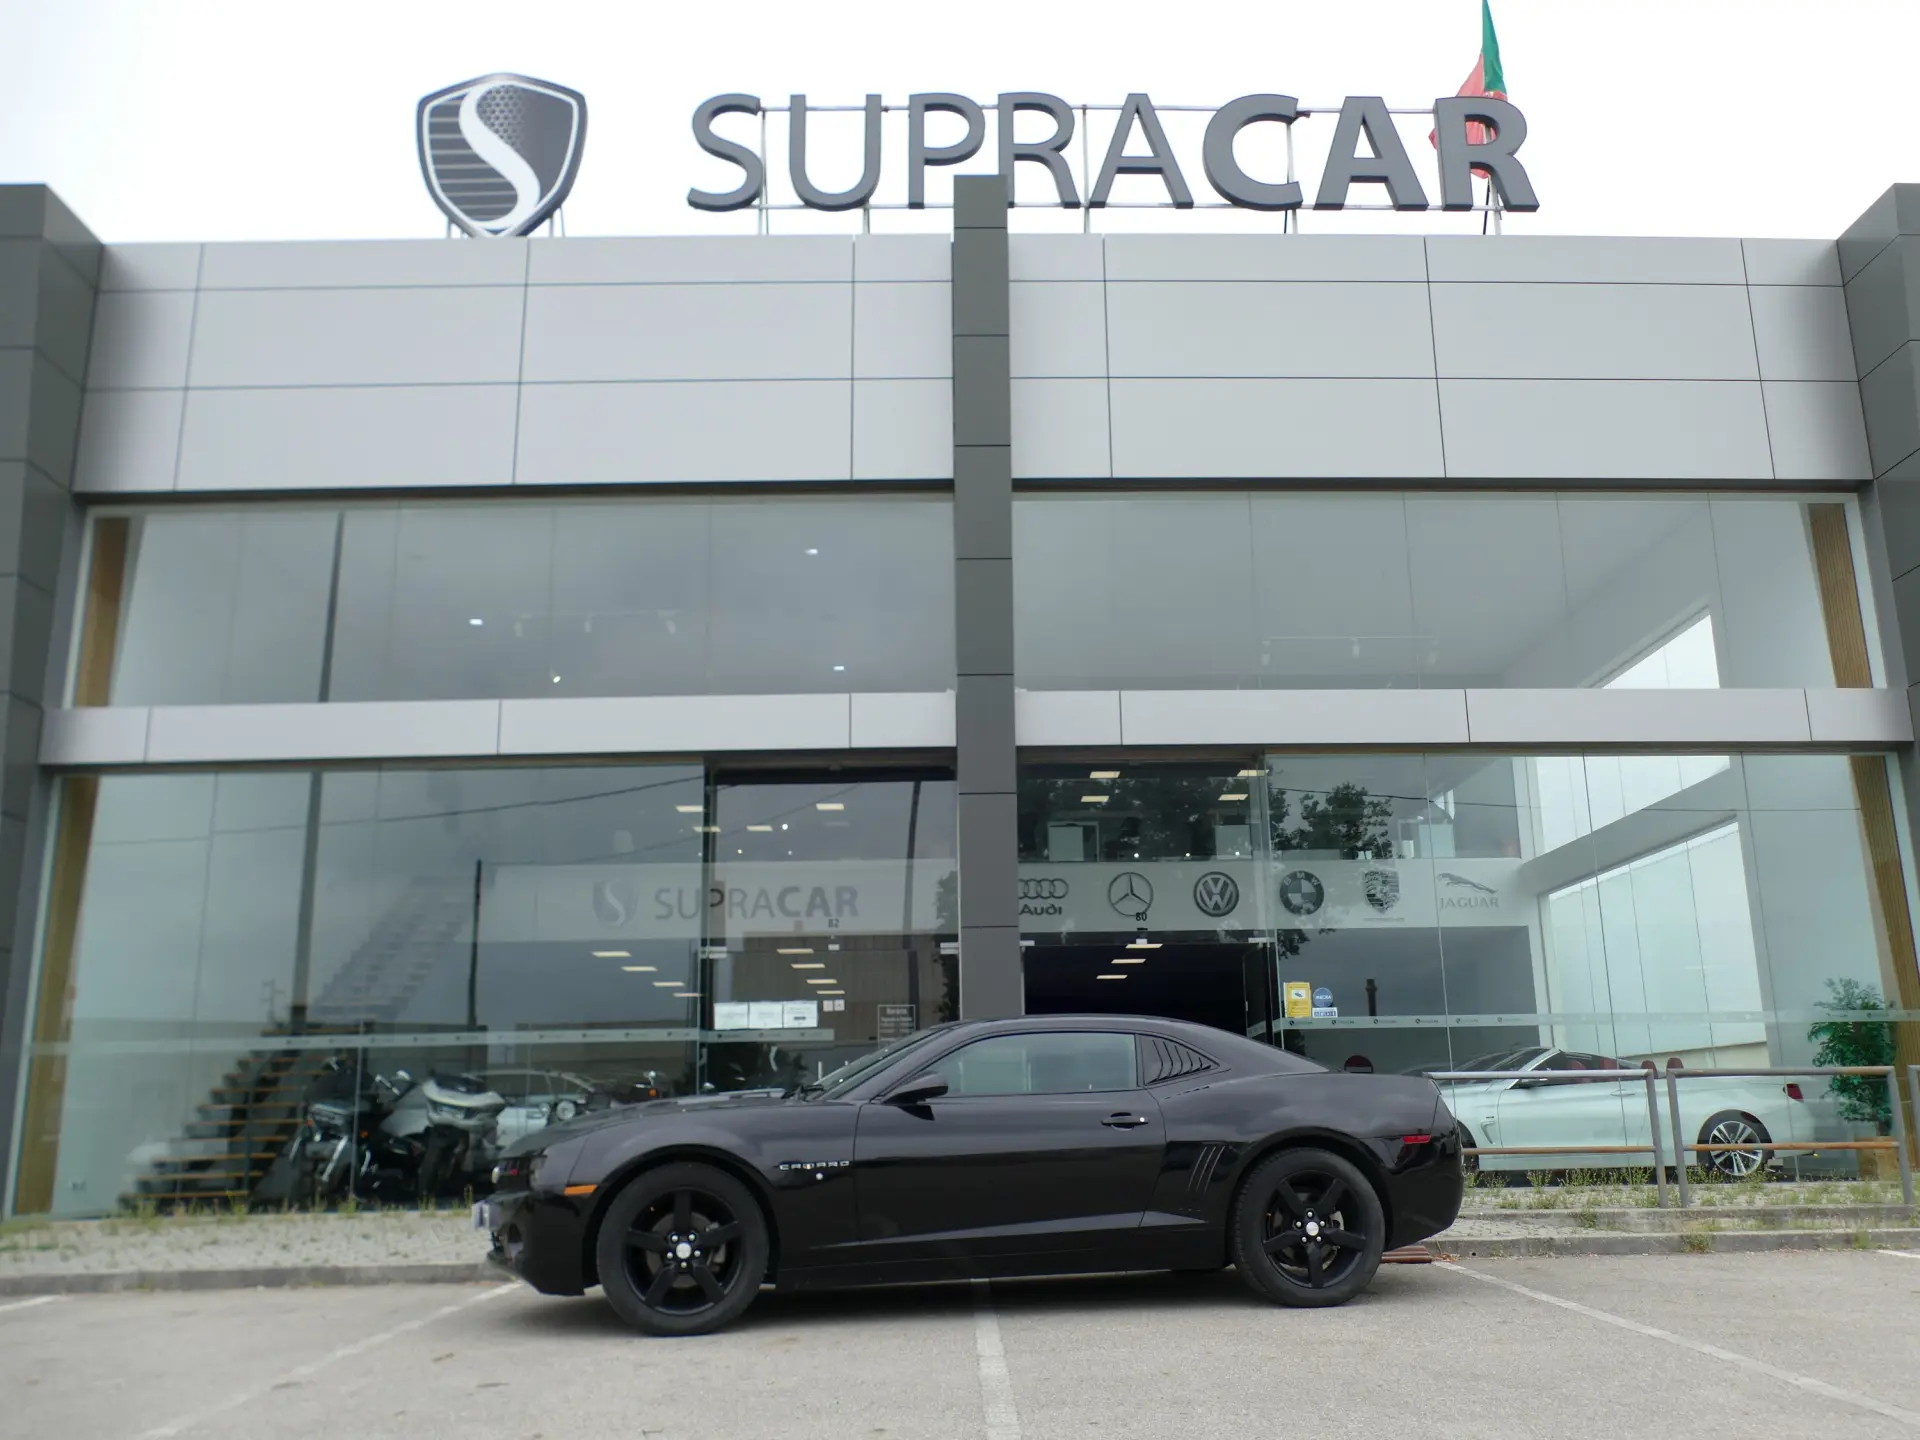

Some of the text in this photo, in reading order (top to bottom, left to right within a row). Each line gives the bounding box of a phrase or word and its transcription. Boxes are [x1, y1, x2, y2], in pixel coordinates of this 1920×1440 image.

[687, 92, 1539, 213] SUPRACAR
[654, 886, 859, 920] SUPRACAR
[1020, 903, 1063, 916] Audi
[1439, 897, 1500, 910] JAGUAR
[1135, 912, 1148, 922] 80
